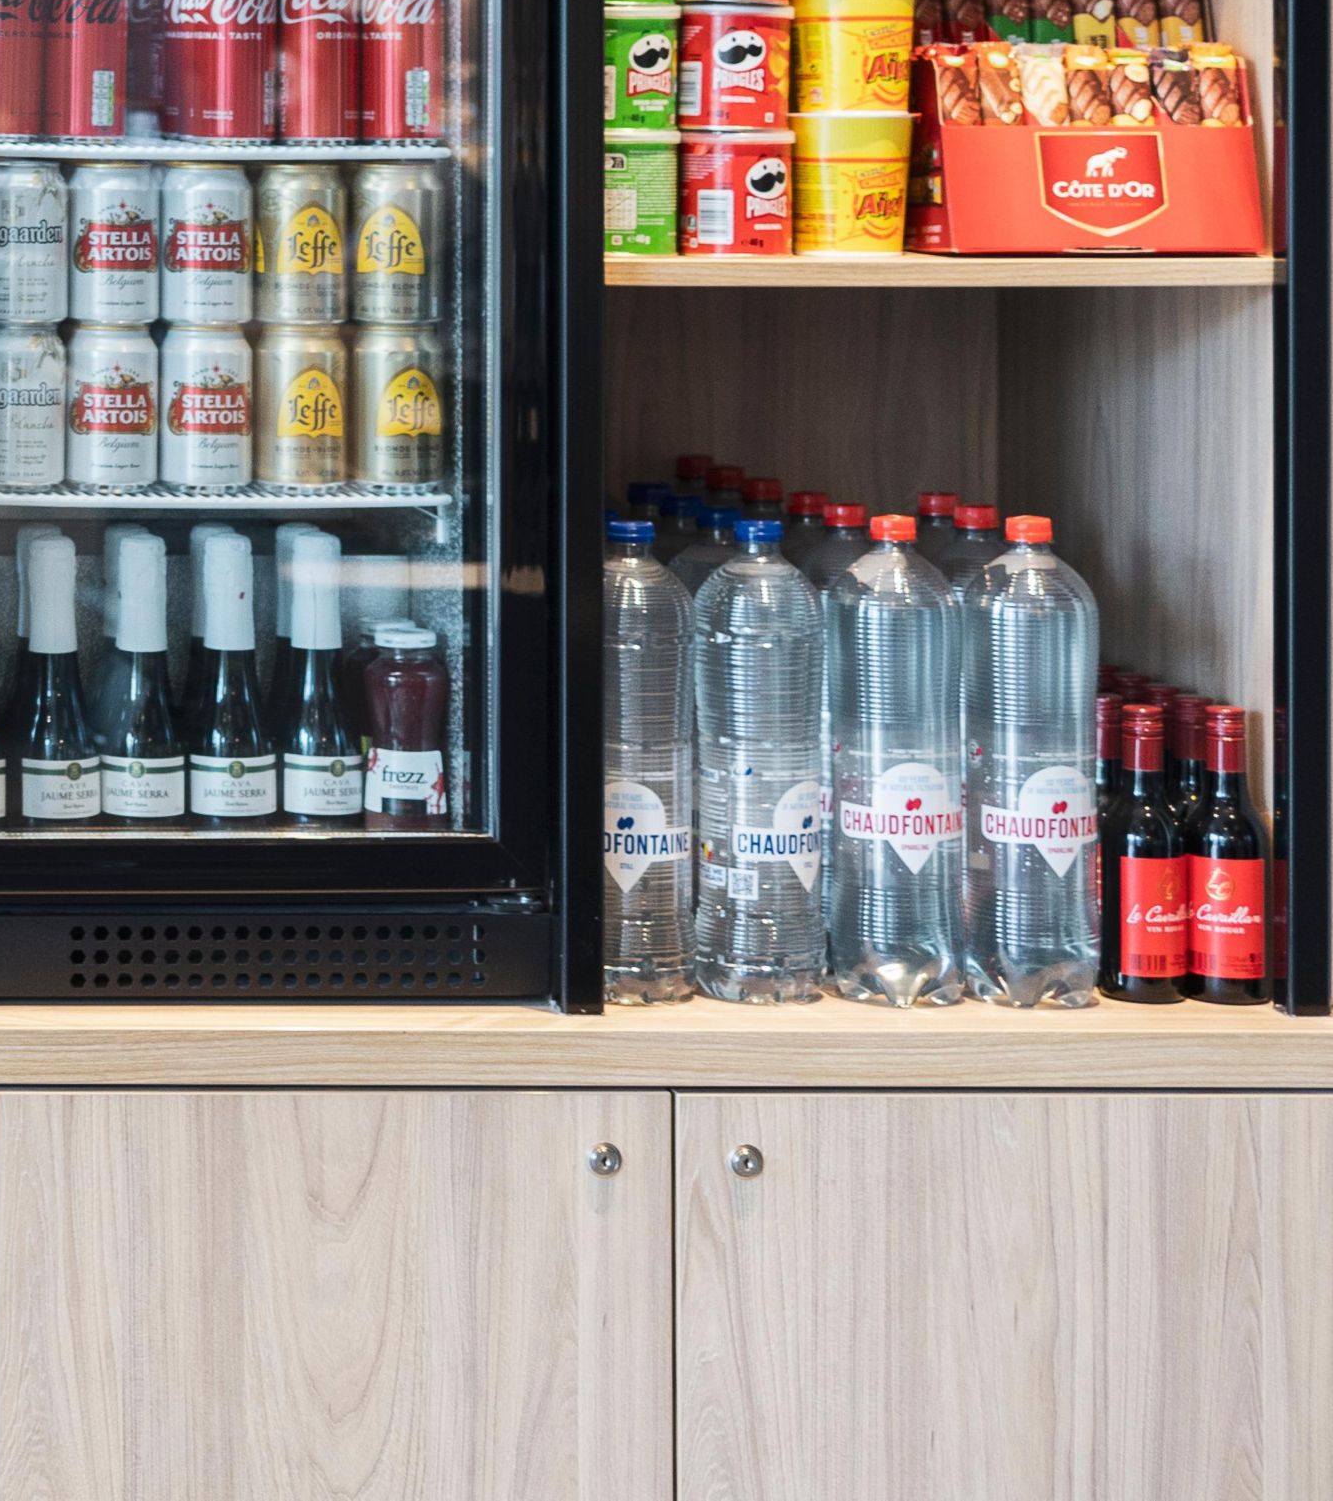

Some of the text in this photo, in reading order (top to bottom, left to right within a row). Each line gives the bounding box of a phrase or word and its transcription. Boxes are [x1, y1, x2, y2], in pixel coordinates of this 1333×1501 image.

[1052, 178, 1104, 198] CÔTE
[88, 231, 151, 245] STELLA
[176, 231, 241, 245] STELLA
[87, 247, 152, 261] ARTOIS
[175, 247, 241, 261] ARTOIS
[288, 229, 338, 268] Leffe
[365, 229, 417, 267] Leffe
[83, 392, 147, 407] STELLA
[182, 393, 245, 408] STELLA
[82, 409, 147, 424] ARTOIS
[181, 409, 245, 424] ARTOIS
[288, 392, 338, 431] Leffe
[387, 391, 436, 431] Leffe
[137, 790, 169, 799] SERRA
